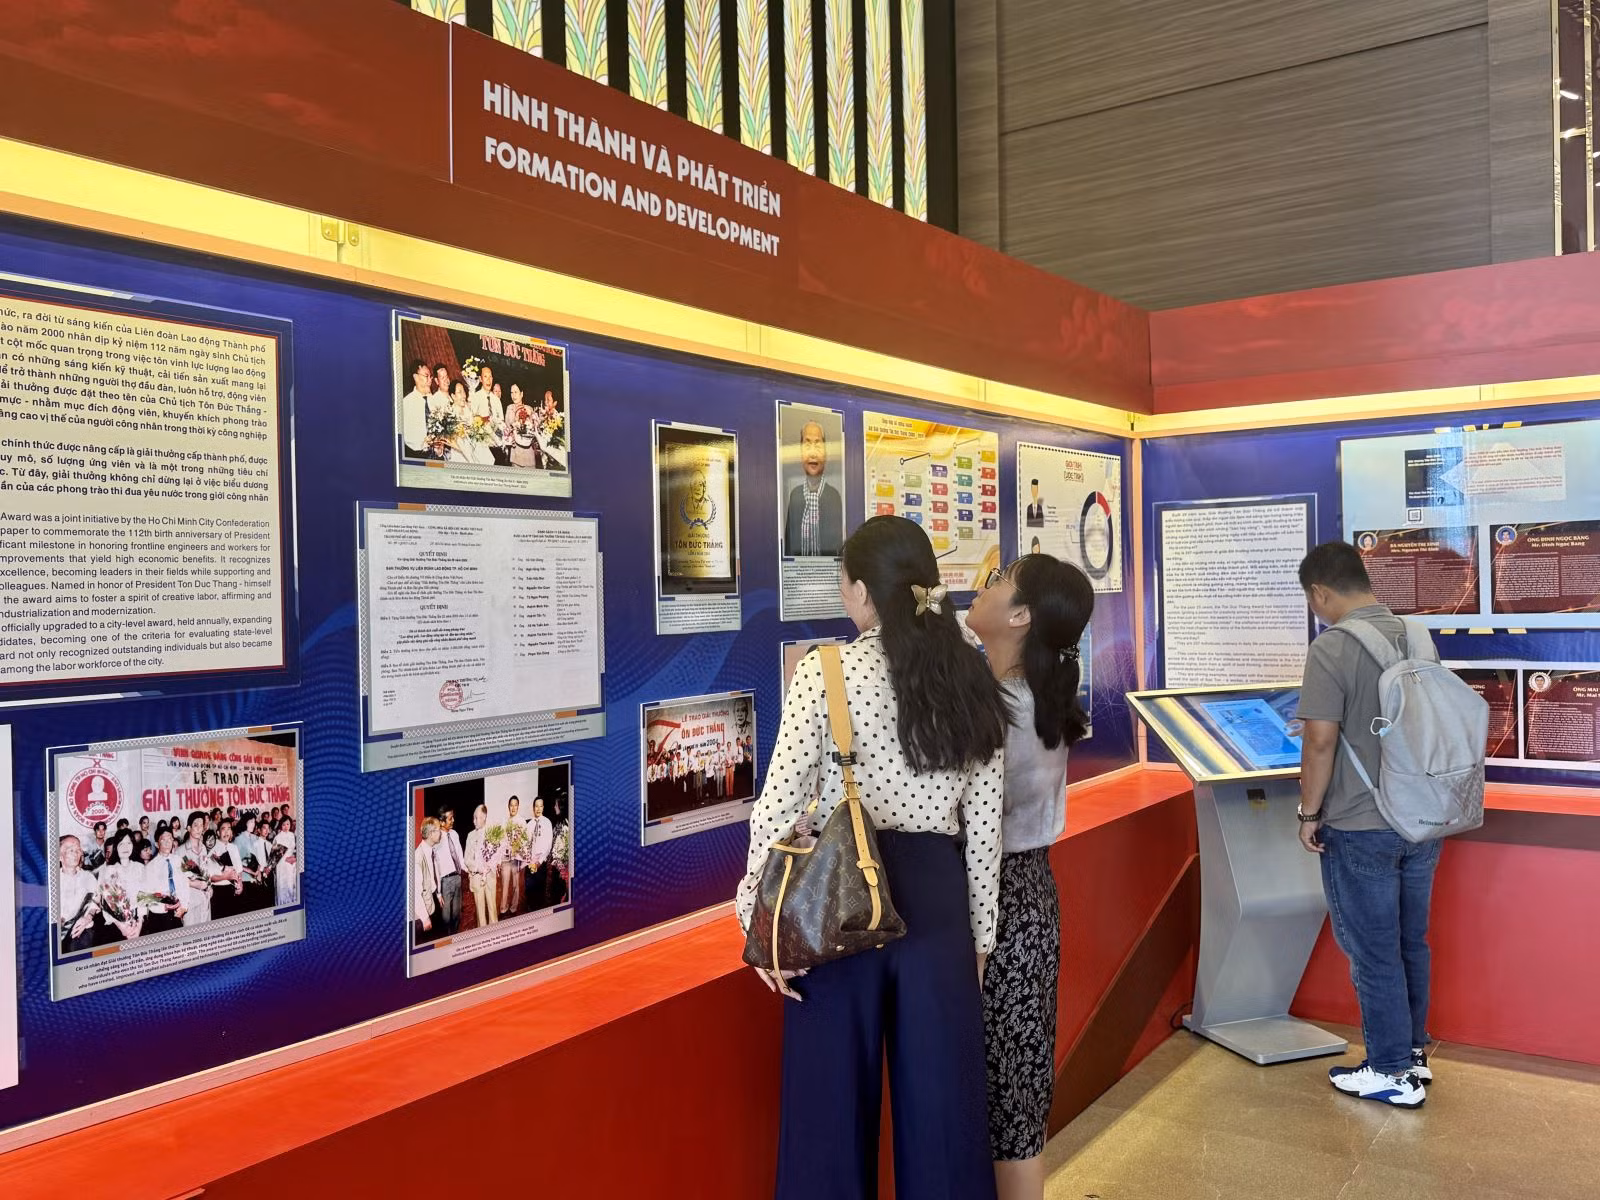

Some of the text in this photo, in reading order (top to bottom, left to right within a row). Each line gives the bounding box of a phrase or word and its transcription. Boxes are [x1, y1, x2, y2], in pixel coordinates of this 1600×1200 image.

[483, 79, 781, 218] HÌNH THÀNH VÀ PHÁT TRIỂN
[484, 135, 780, 257] FORMATION AND DEVELOPMENT
[40, 326, 65, 339] 2000
[67, 330, 92, 342] nhân
[94, 334, 110, 347] dịp
[125, 338, 148, 351] niệm
[150, 341, 166, 352] 112
[212, 350, 230, 361] sinh
[232, 352, 249, 363] Chủ
[250, 355, 266, 367] tịch
[1, 437, 268, 466] chính thức được nâng cấp là giải thưởng cấp thành phố, được
[0, 511, 32, 522] Award
[32, 514, 53, 522] was
[61, 513, 82, 525] joint
[82, 514, 120, 524] initiative
[120, 515, 132, 526] by
[132, 515, 147, 525] the
[147, 516, 161, 525] Ho
[161, 516, 176, 525] Chi
[177, 516, 198, 526] Minh
[198, 517, 215, 528] City
[215, 518, 270, 528] Confederation
[0, 526, 270, 540] paper to commemorate the 112th birth anniversary of President
[51, 567, 271, 579] becoming leaders in their fields while supporting and
[50, 579, 271, 591] Named in honor of President Ton Duc Thang himself
[3, 594, 19, 605] the
[22, 594, 52, 604] award
[54, 594, 78, 604] aims
[80, 592, 89, 603] to
[91, 593, 117, 603] foster
[127, 592, 149, 604] spirit
[151, 592, 160, 602] of
[161, 592, 195, 601] creative
[196, 592, 219, 601] labor,
[221, 591, 255, 602] affirming
[257, 591, 272, 599] and
[0, 615, 272, 634] officially upgraded to a city-level award, held annually, expanding
[0, 655, 164, 677] among the labor workforce of the city.
[213, 772, 239, 784] TRAO
[226, 785, 247, 806] TÔN
